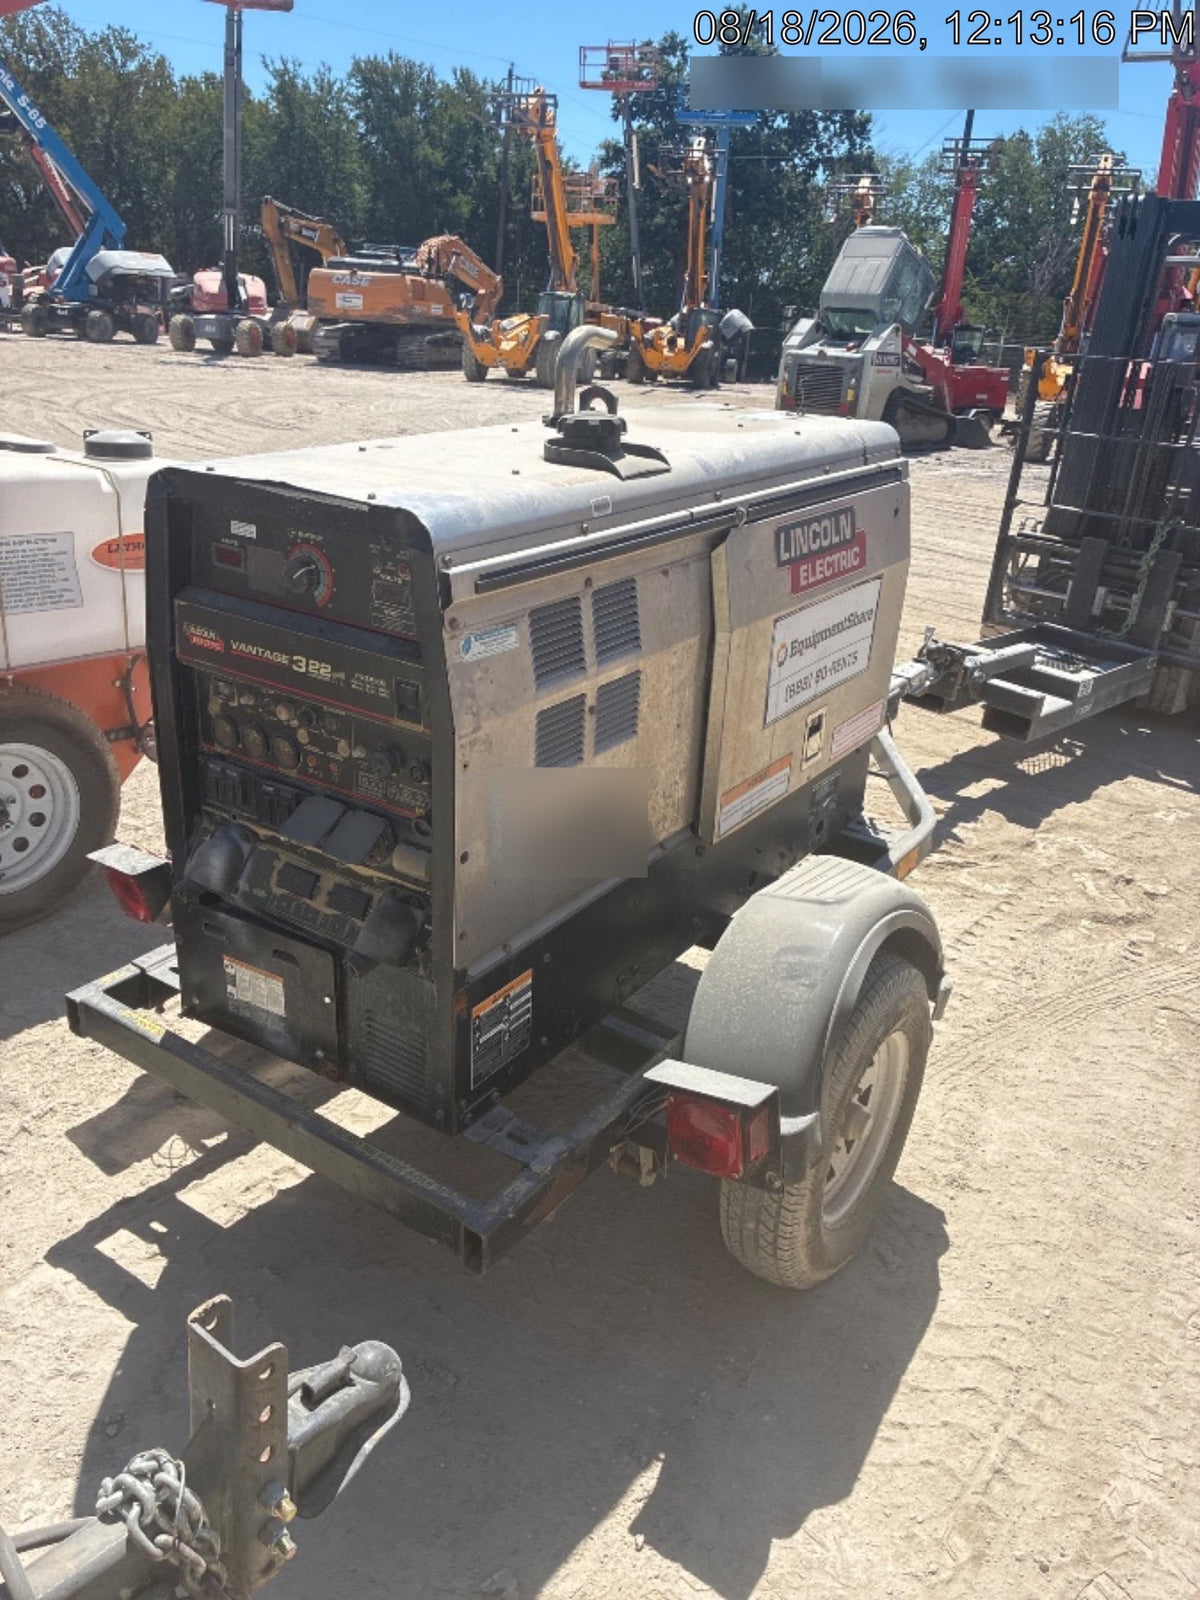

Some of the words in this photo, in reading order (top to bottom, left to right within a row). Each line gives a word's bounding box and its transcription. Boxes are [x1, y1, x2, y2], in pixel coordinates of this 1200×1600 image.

[17, 95, 47, 129] S-65
[331, 274, 373, 287] CASE
[779, 511, 852, 561] LINCOLN
[799, 546, 861, 587] ELECTRIC
[789, 607, 875, 659] EquipmentShare
[230, 639, 291, 665] VANTAGE
[291, 655, 332, 678] 322
